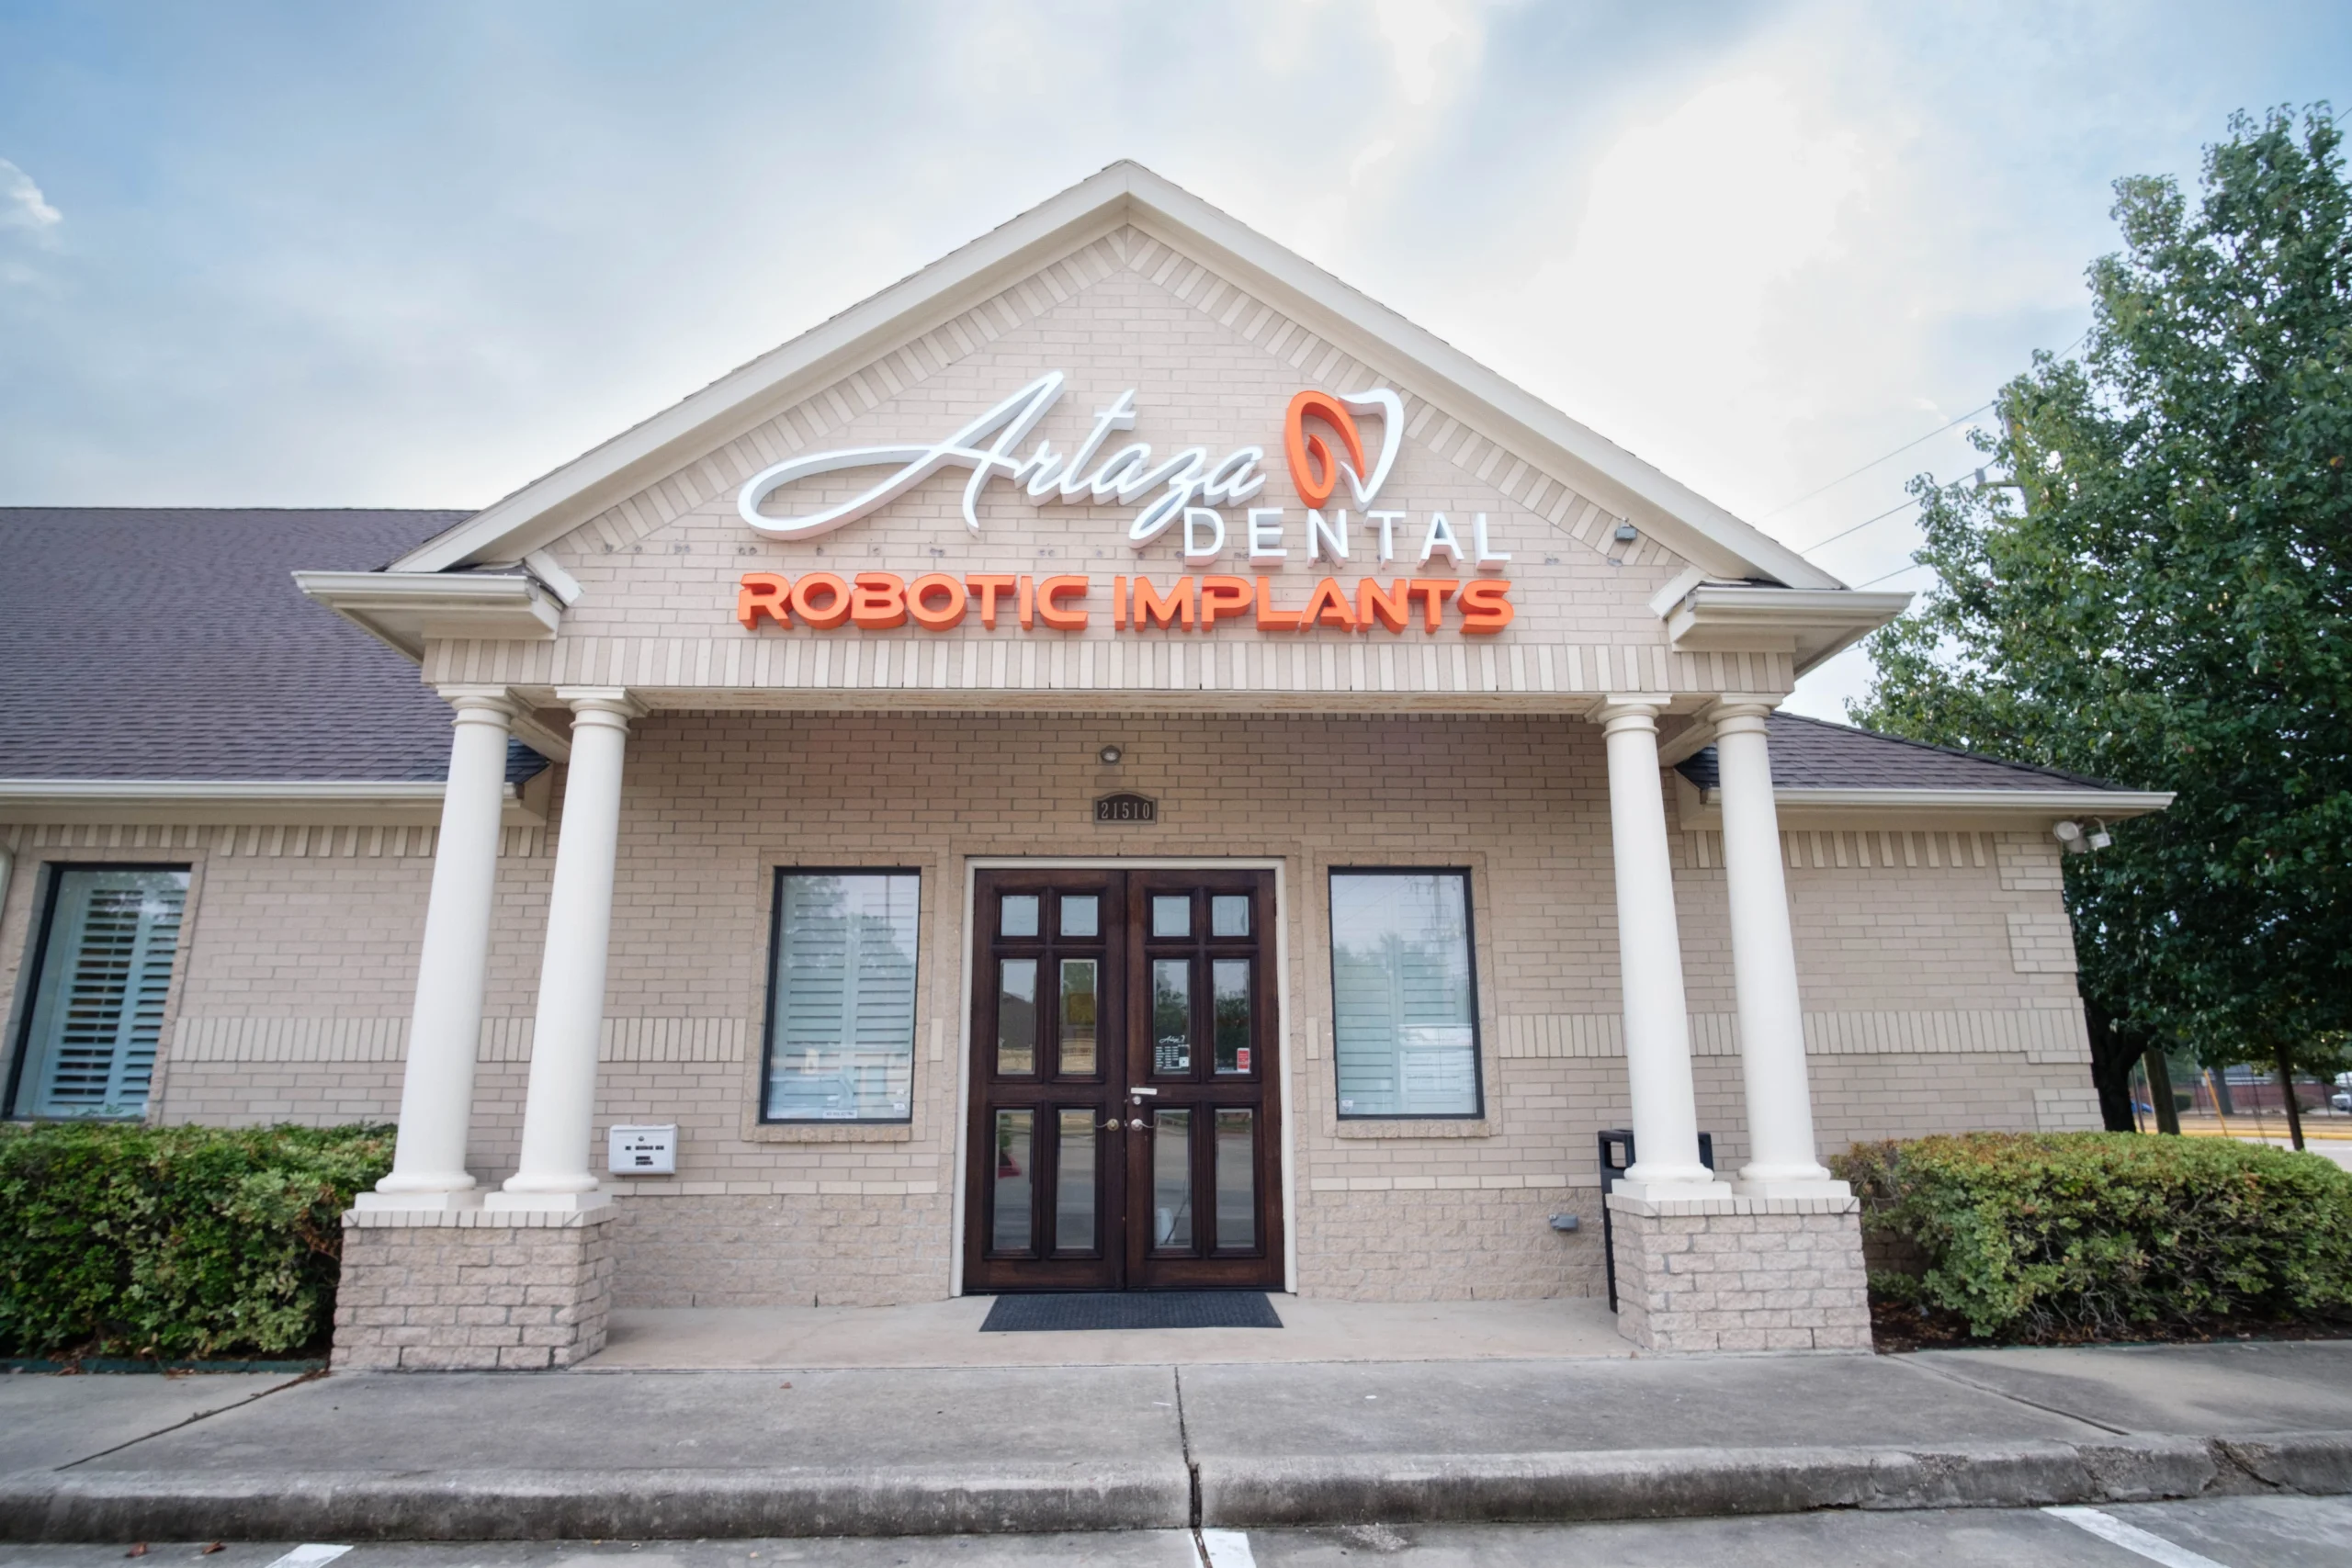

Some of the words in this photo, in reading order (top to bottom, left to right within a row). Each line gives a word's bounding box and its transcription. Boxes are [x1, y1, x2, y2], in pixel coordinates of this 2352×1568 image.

[738, 370, 1266, 549] Artaza
[1183, 507, 1511, 571] DENTAL
[738, 572, 1090, 632] ROBOTIC
[1114, 576, 1515, 635] IMPLANTS
[1101, 802, 1150, 819] 21510
